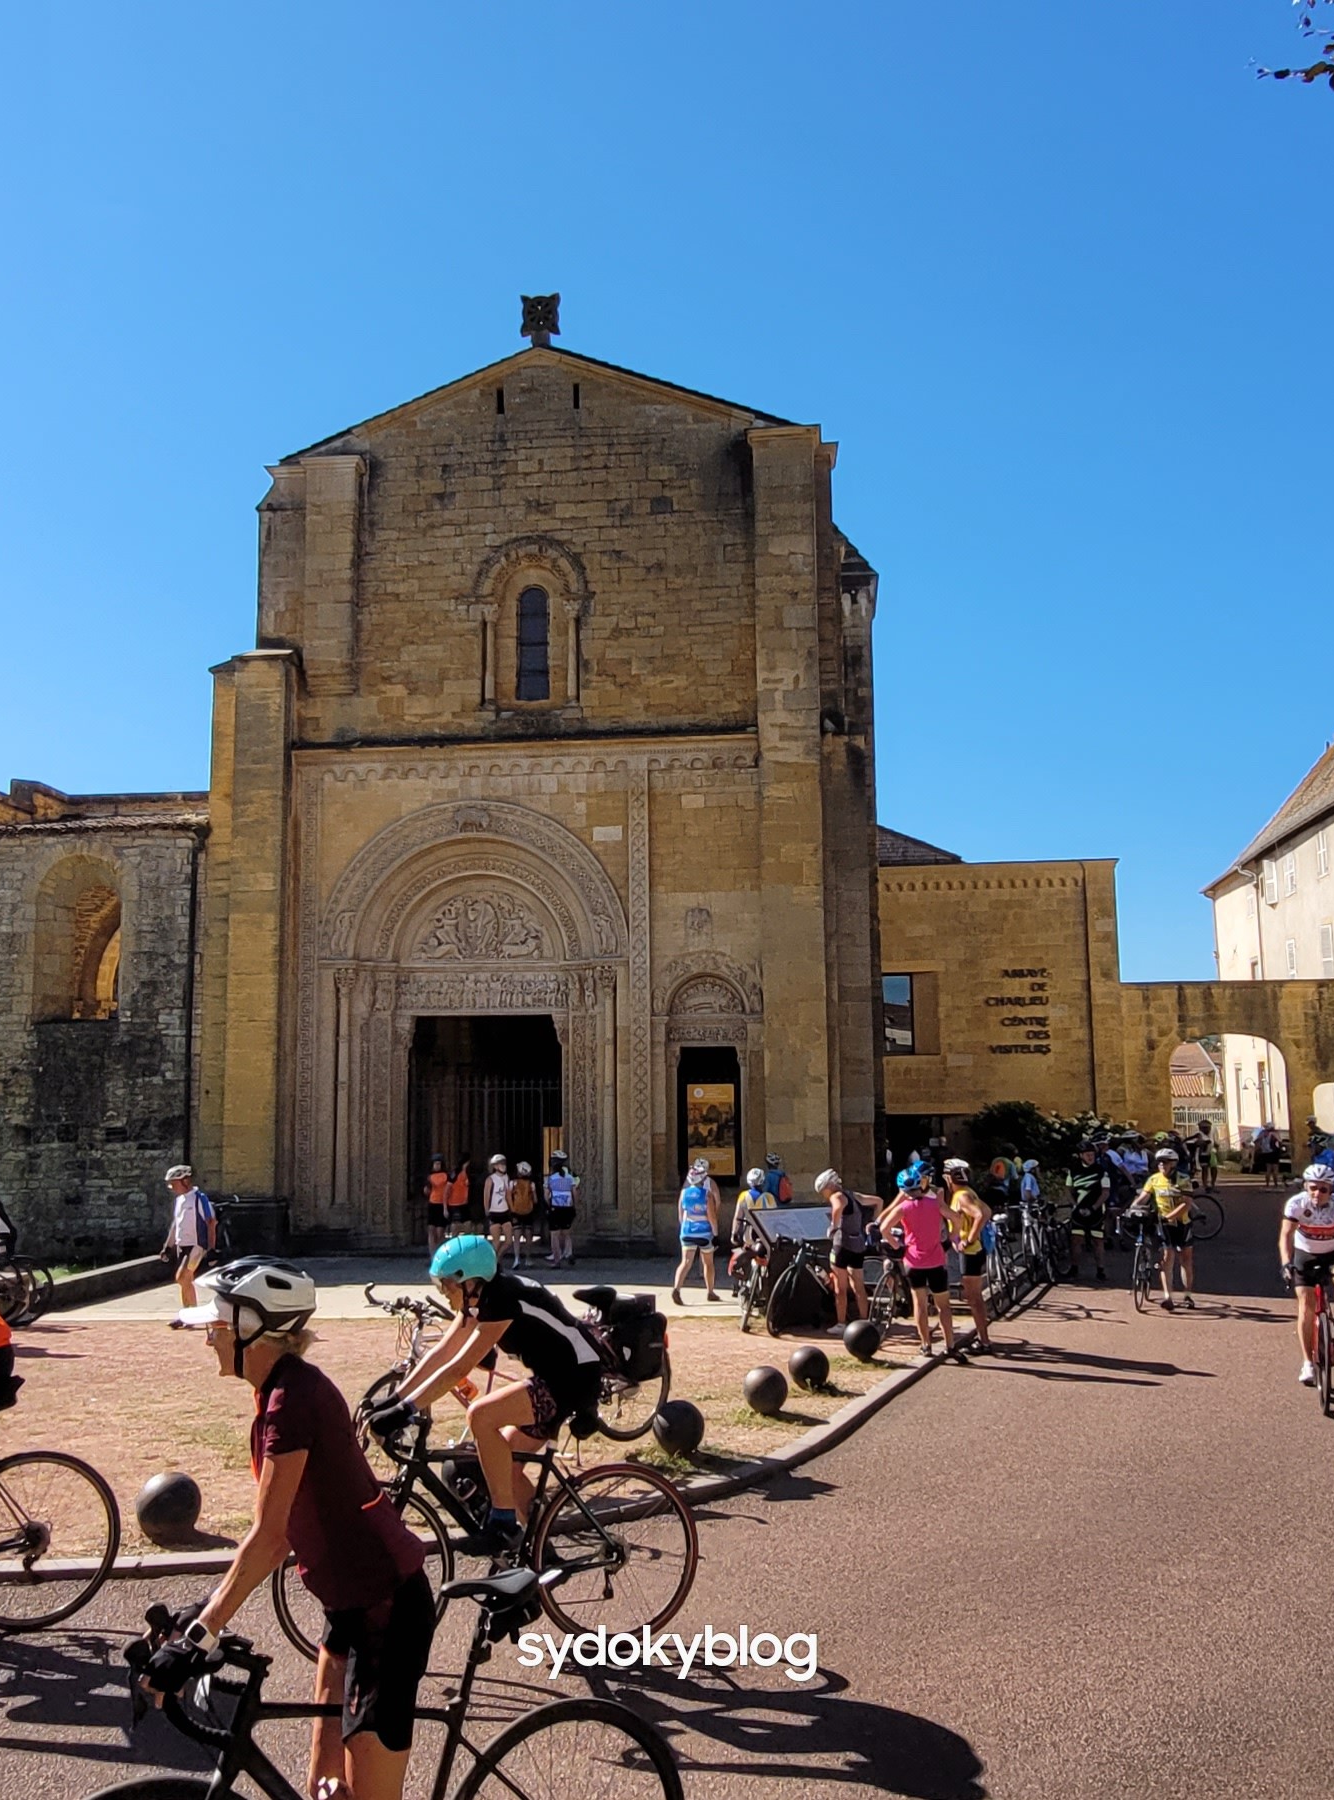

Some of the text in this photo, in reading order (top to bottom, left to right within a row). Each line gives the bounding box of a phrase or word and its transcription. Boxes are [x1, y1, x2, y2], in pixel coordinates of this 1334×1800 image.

[1030, 982, 1048, 992] DE
[985, 996, 1049, 1007] CHARLIEU
[1025, 1030, 1051, 1040] DES
[988, 1044, 1052, 1055] VISITEURS
